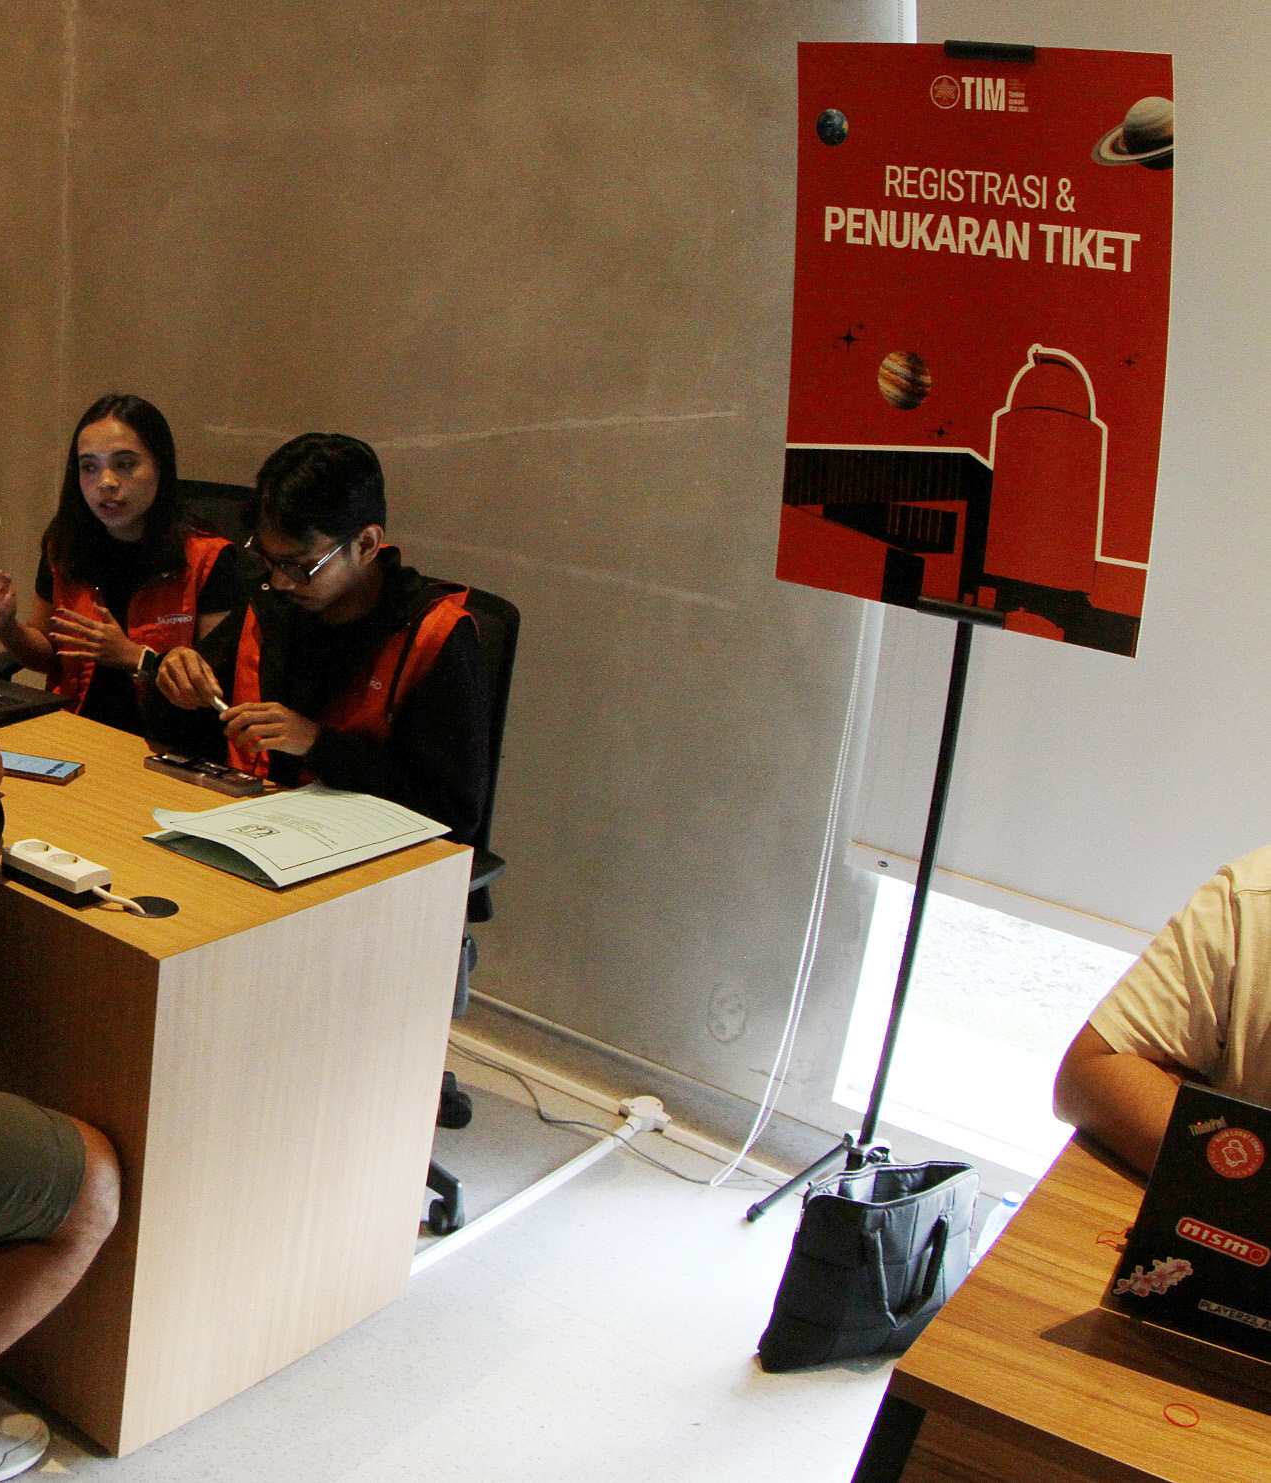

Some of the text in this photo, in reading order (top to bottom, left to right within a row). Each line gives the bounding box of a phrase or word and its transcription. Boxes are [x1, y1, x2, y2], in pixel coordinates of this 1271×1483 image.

[961, 76, 1006, 112] TIM
[884, 165, 1076, 213] REGISTRASI &
[824, 206, 1141, 273] PENUKARAN TIKET
